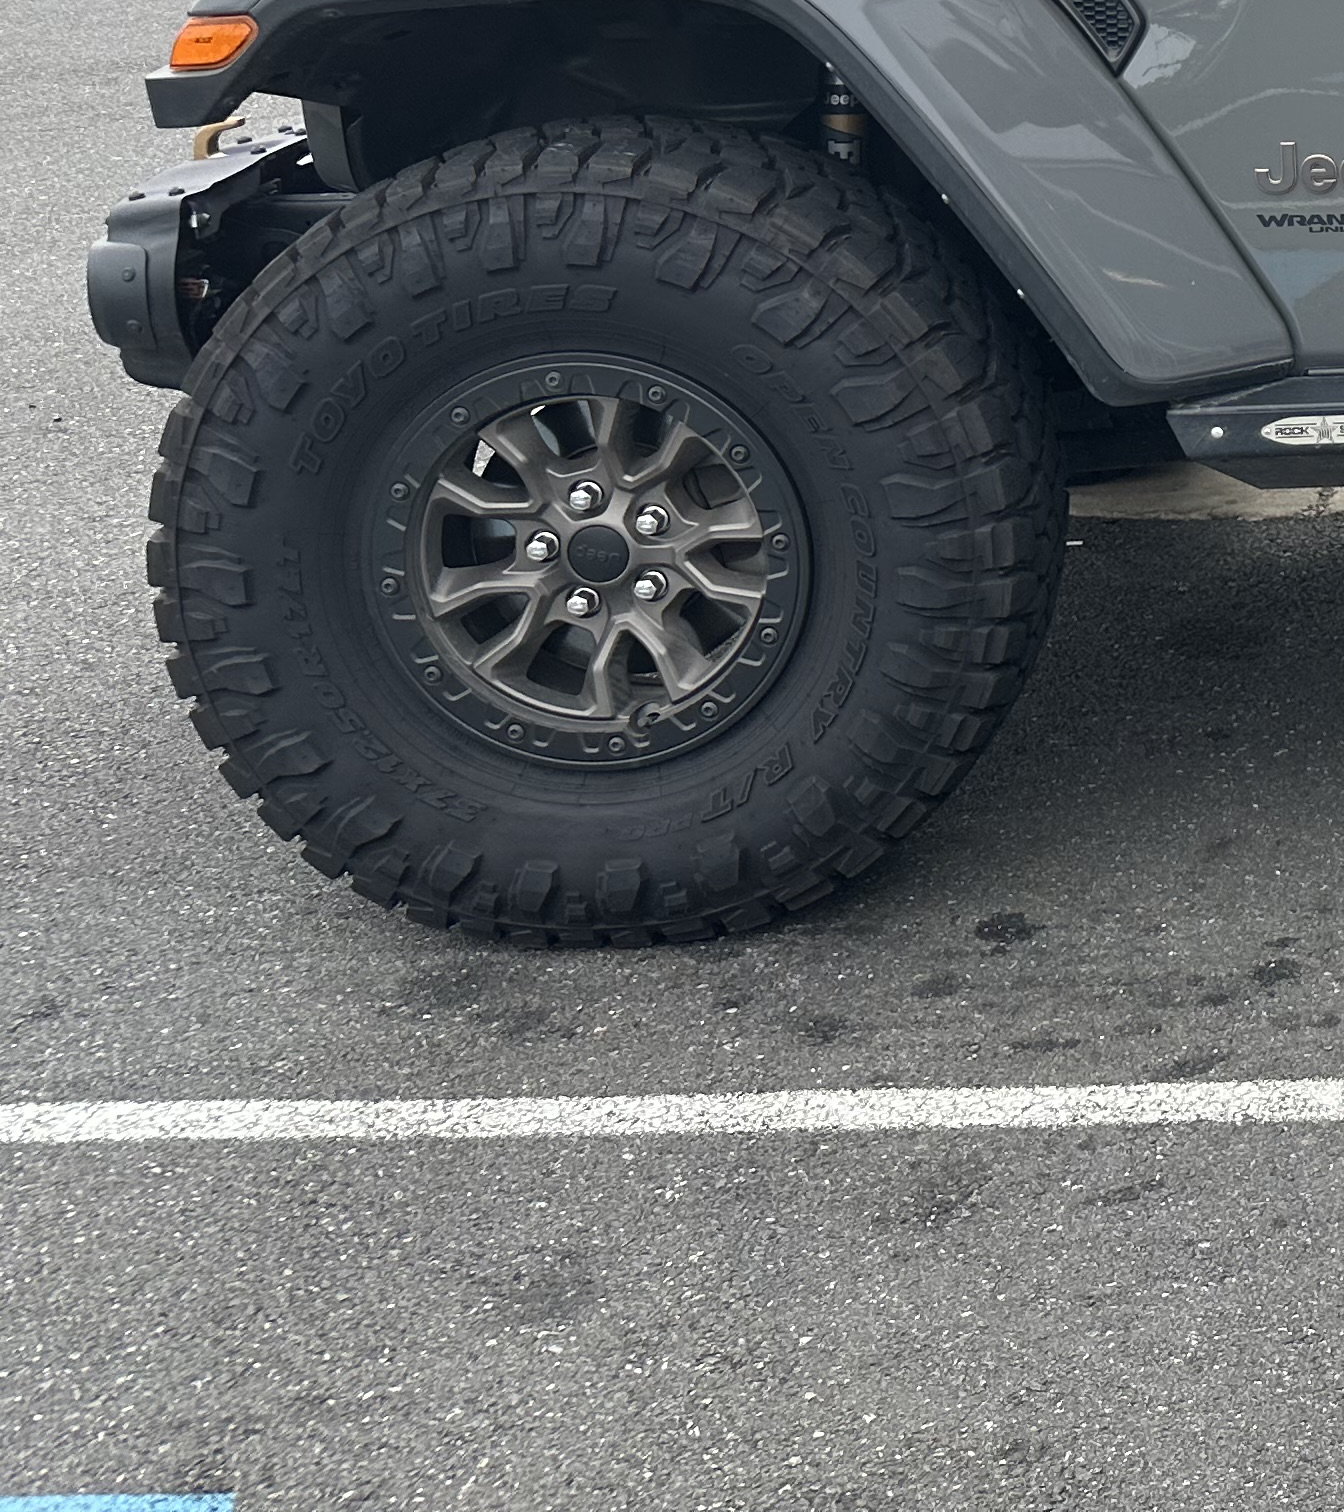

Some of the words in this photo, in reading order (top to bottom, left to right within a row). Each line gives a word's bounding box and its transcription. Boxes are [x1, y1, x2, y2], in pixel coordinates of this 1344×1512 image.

[288, 335, 406, 475] TOYO
[409, 284, 618, 347] TIRES
[730, 343, 855, 471] OPEN
[811, 482, 878, 744] COUNTRY
